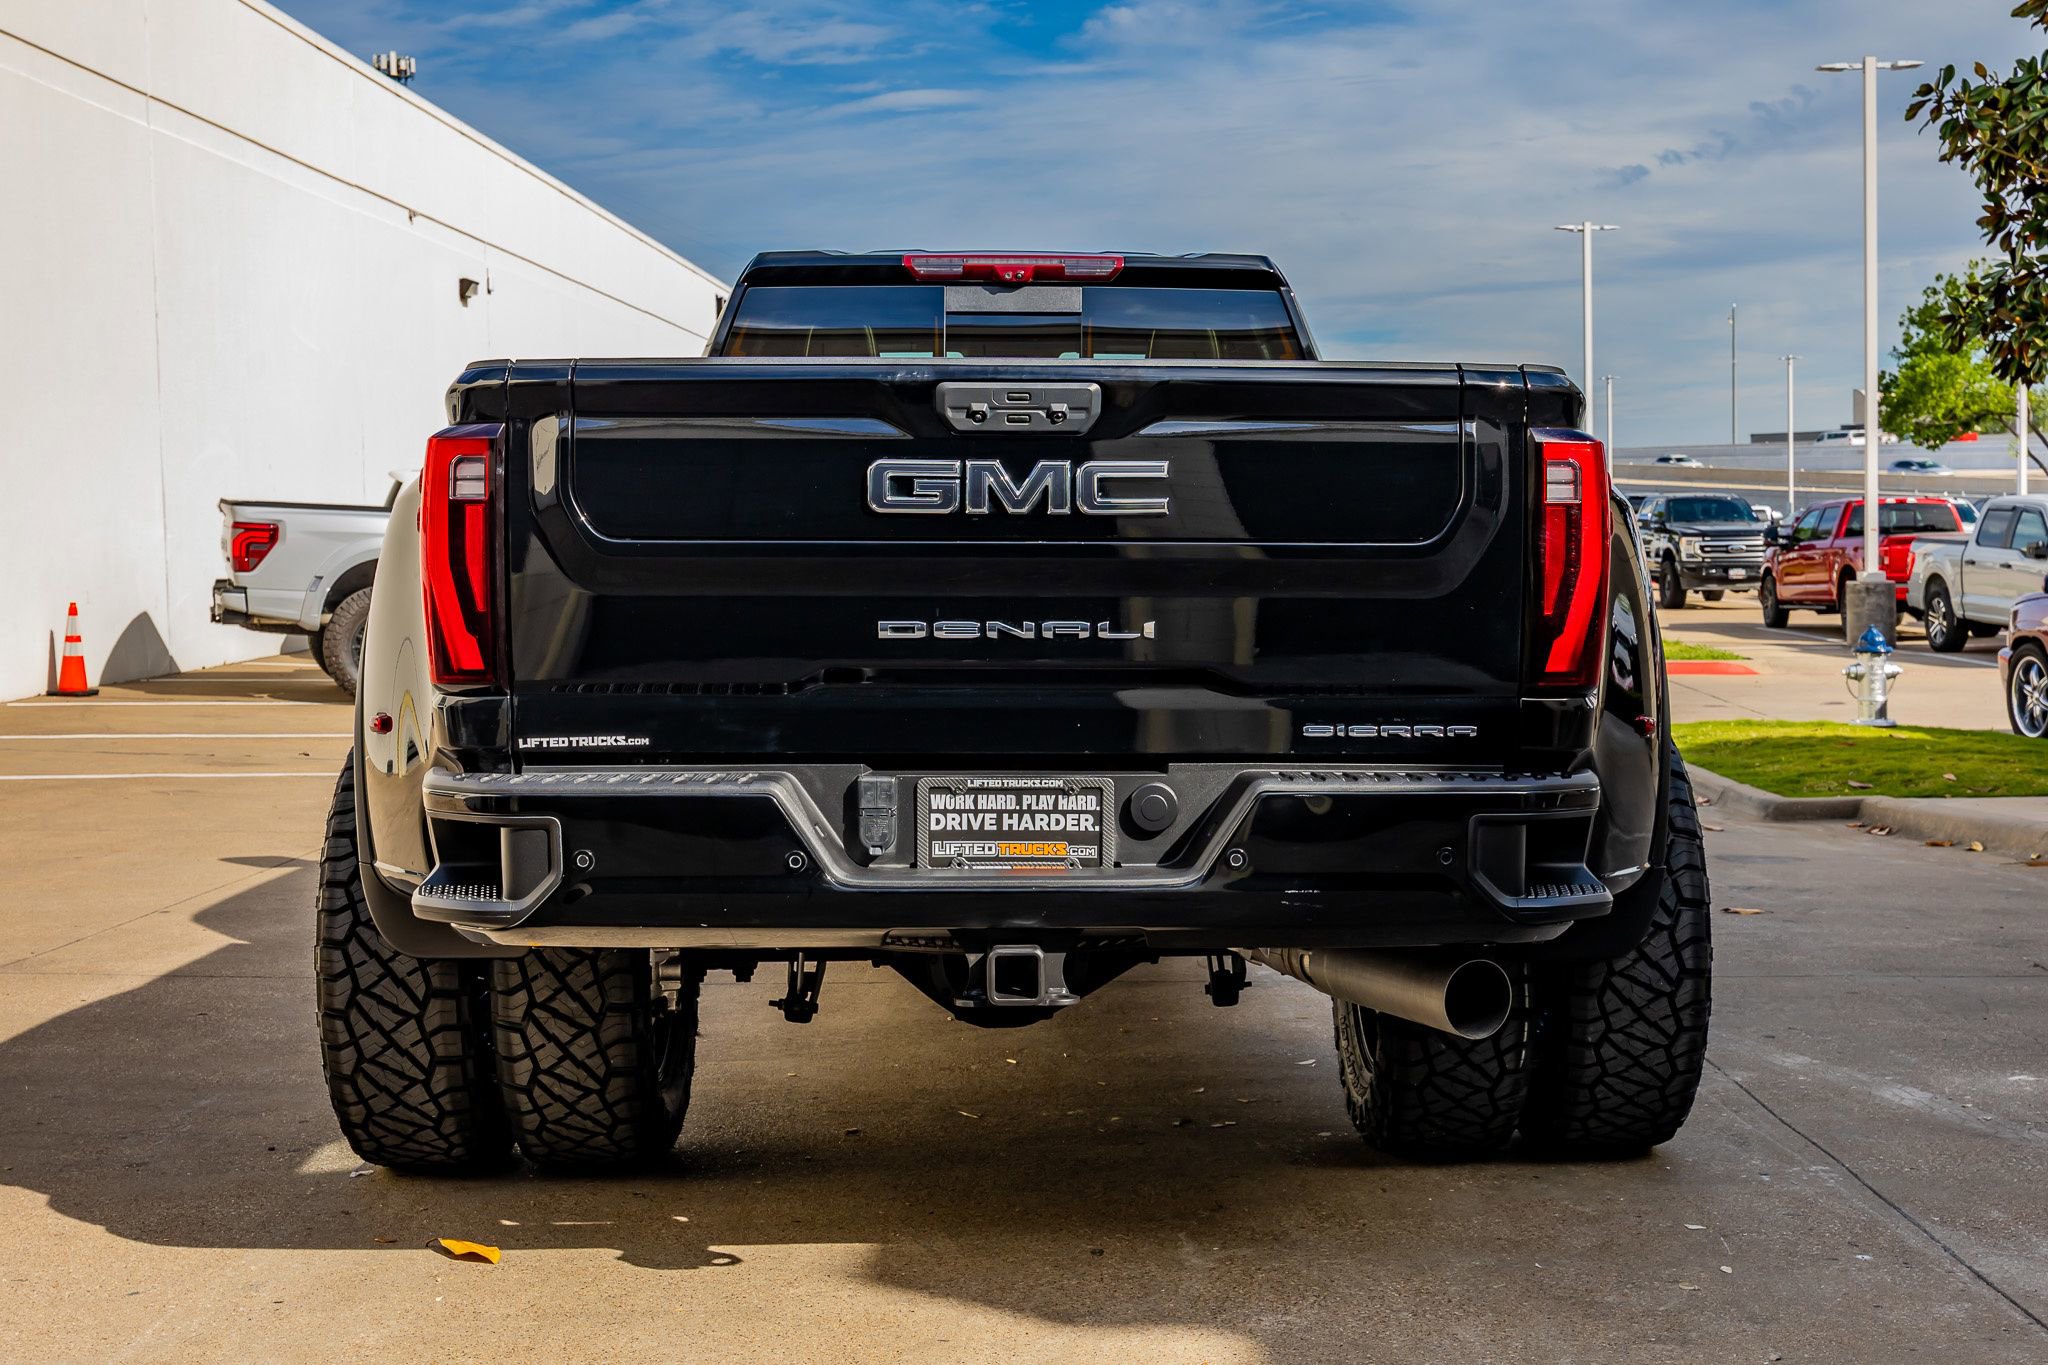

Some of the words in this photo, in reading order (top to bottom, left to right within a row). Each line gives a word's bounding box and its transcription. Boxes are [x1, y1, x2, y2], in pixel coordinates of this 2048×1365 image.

[867, 458, 1169, 515] GMC
[877, 620, 1156, 639] DENALI
[1302, 725, 1478, 738] SIERRA
[930, 794, 975, 810] WORK
[977, 794, 1020, 811] HARD.
[1022, 794, 1056, 811] PLAY
[1058, 795, 1101, 811] HARD.
[930, 813, 997, 831] DRIVE
[1002, 813, 1100, 831] HARDER.
